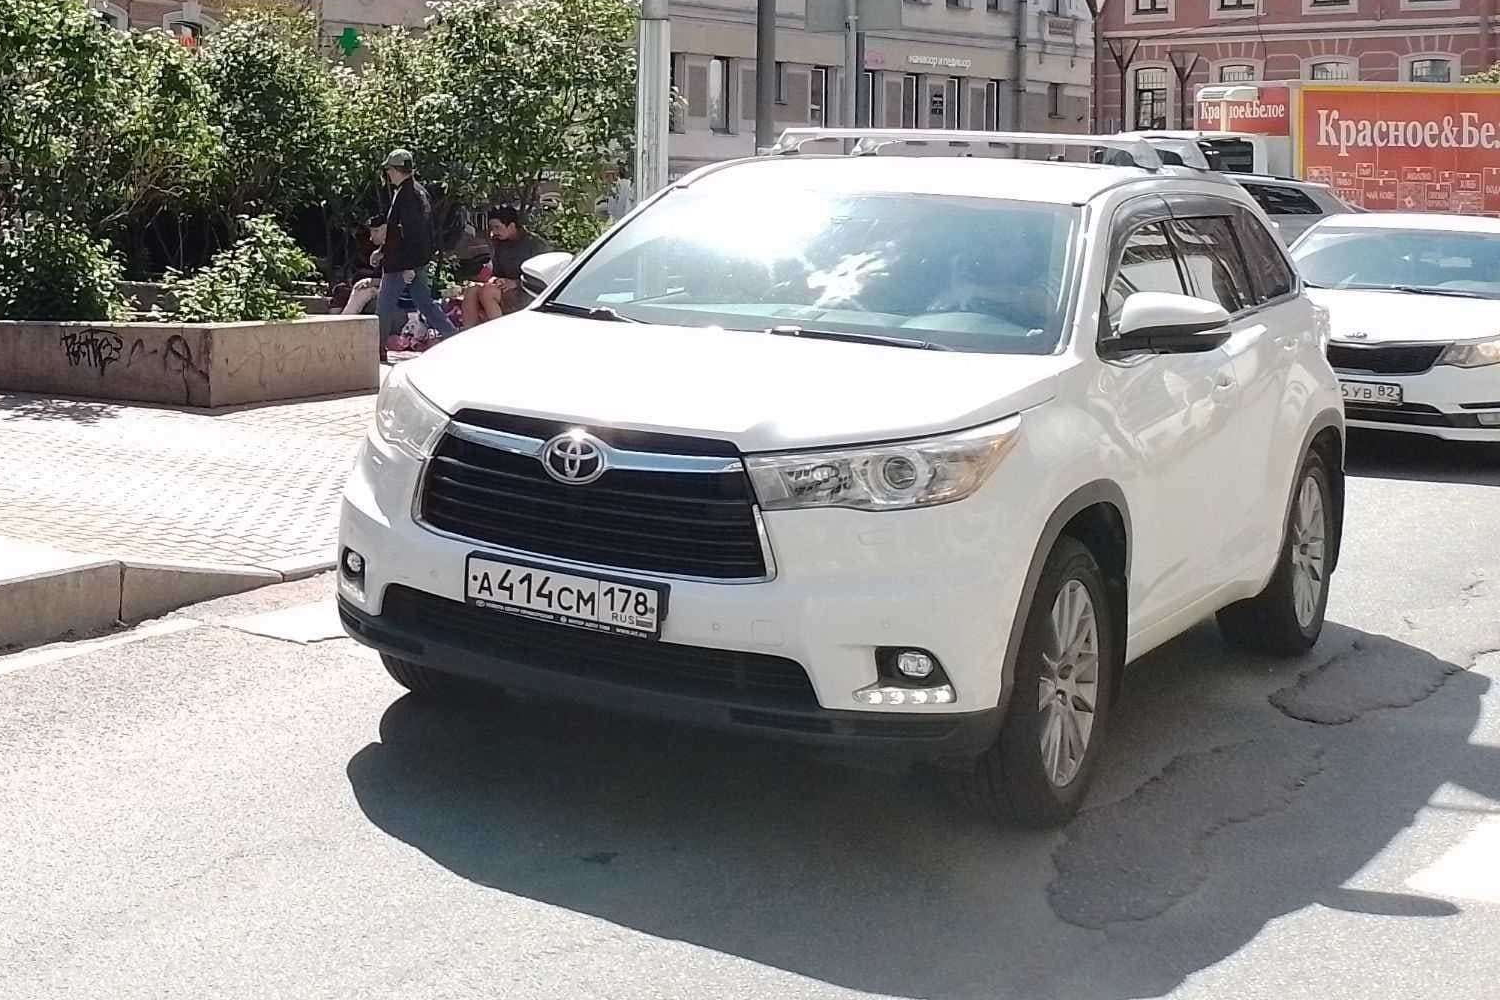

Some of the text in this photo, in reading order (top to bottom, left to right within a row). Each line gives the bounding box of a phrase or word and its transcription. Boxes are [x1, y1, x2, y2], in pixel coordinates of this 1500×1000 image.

[1200, 100, 1285, 125] Краое&Белое
[477, 568, 597, 617] А414СМ
[603, 586, 649, 617] 178
[611, 612, 635, 625] RUS
